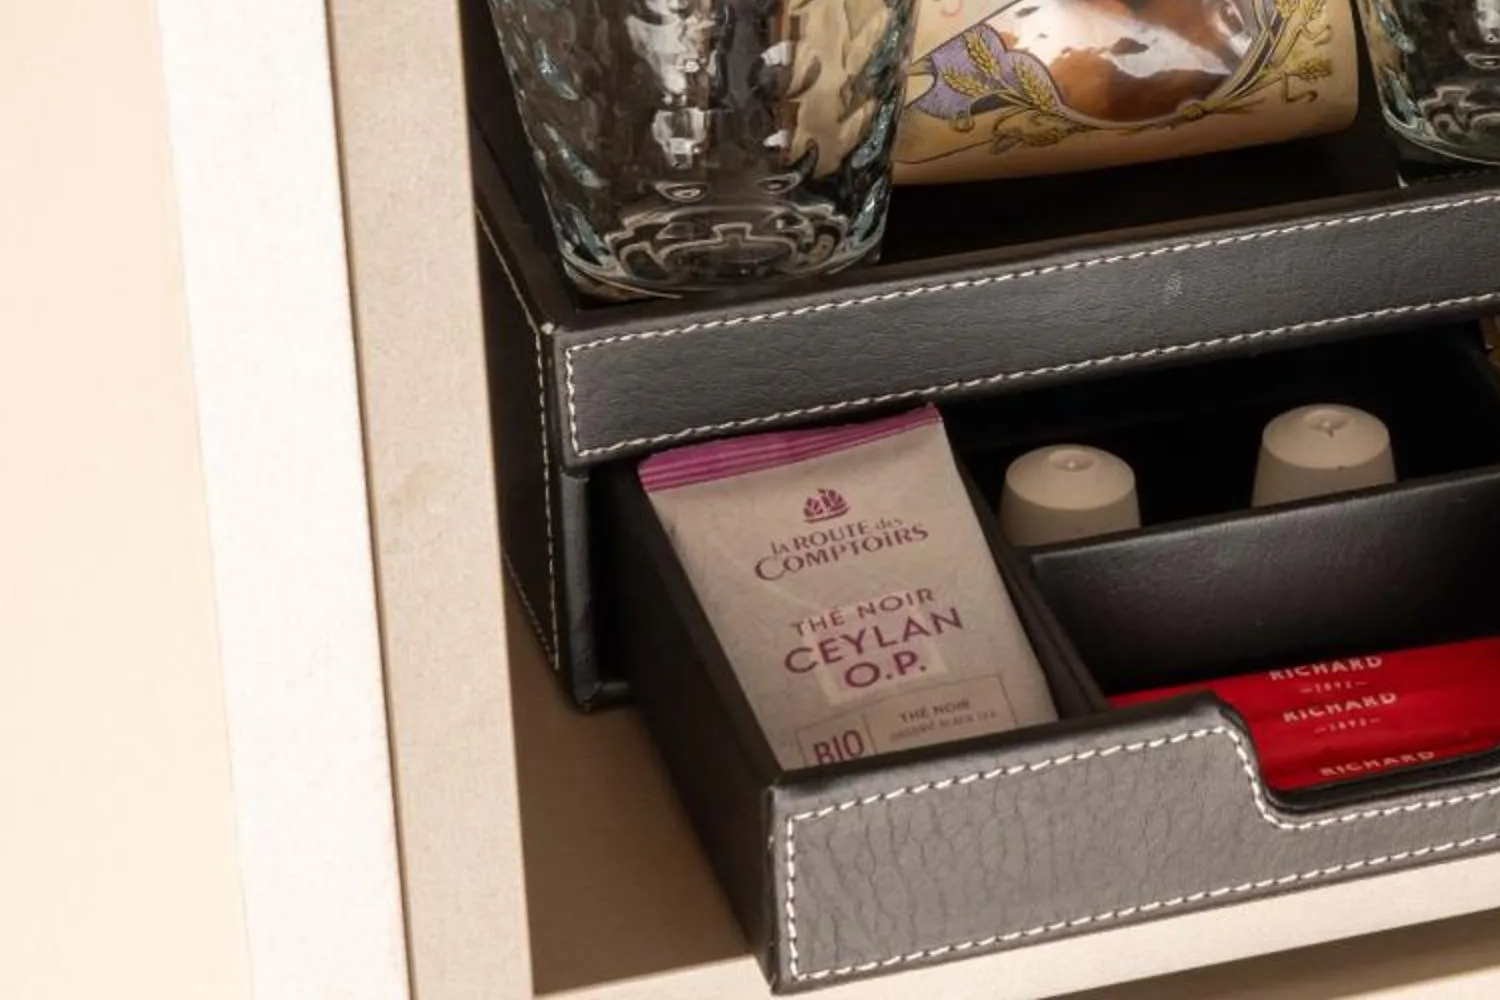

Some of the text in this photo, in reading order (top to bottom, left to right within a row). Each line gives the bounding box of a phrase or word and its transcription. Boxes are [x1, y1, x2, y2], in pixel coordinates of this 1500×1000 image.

[792, 520, 869, 551] ROUTE
[754, 525, 930, 582] COMPTOIRS
[857, 588, 935, 619] NOIR
[784, 607, 964, 674] CEYLAN
[844, 650, 928, 689] O.P.
[1268, 655, 1384, 682] RICHARD
[1282, 692, 1398, 723] RICHARD
[812, 729, 865, 765] BIO
[1319, 751, 1436, 777] RICHARD
